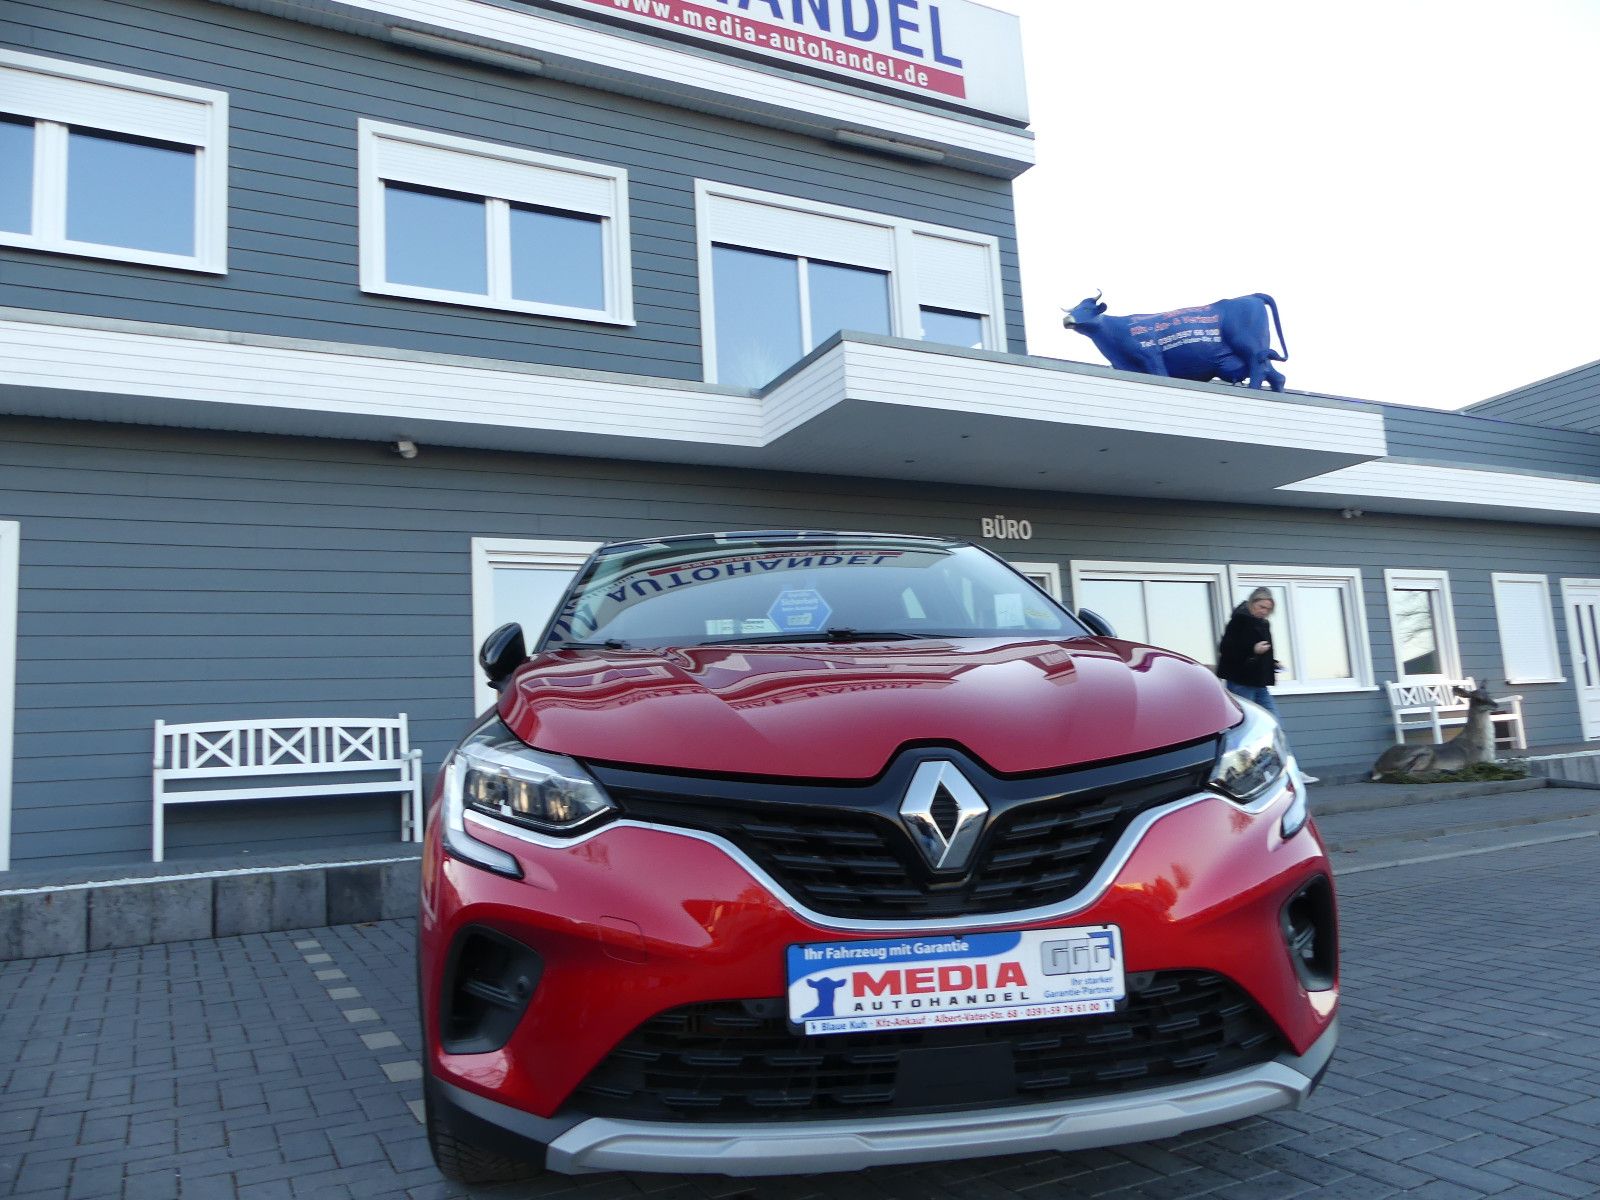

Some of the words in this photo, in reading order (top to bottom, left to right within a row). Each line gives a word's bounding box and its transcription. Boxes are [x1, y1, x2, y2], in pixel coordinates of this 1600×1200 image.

[981, 514, 1032, 540] BÜRO
[804, 948, 823, 960] Ihr
[826, 946, 888, 960] Fahrzeug
[889, 943, 911, 956] mit
[913, 939, 969, 955] Garantie
[852, 961, 1028, 998] MEDIA
[854, 991, 1030, 1012] AUTOHANDEL
